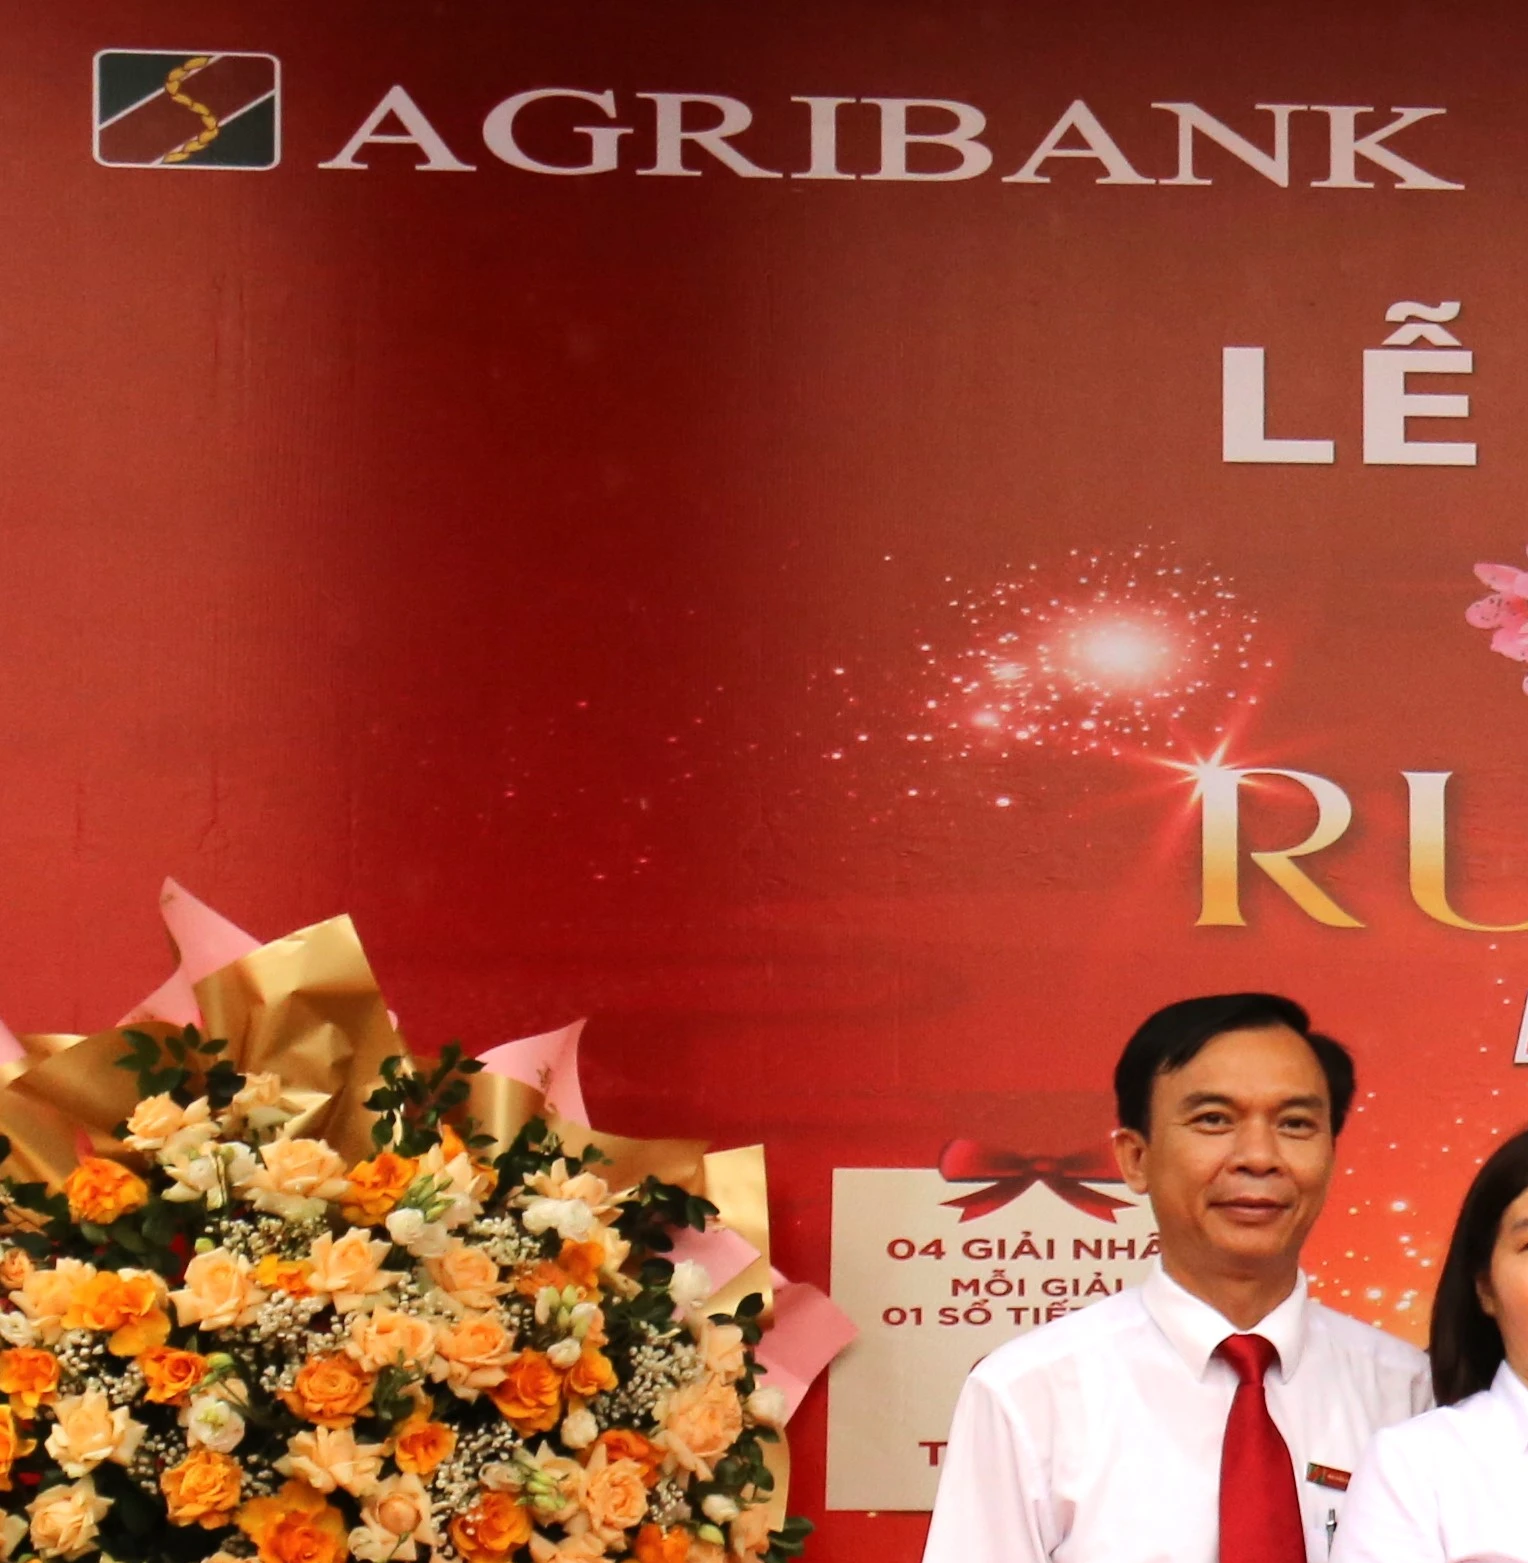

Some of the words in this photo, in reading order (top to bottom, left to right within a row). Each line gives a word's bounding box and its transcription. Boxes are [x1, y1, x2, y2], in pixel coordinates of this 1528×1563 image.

[317, 84, 1465, 191] AGRIBANK
[1221, 299, 1478, 467] LỄ
[886, 1238, 946, 1261] 04
[961, 1231, 1055, 1260] GIẢI
[951, 1269, 1025, 1297] MỖI
[1041, 1272, 1123, 1297] GIẢI
[882, 1306, 923, 1326] 01
[1006, 1299, 1084, 1326] TIẾ
